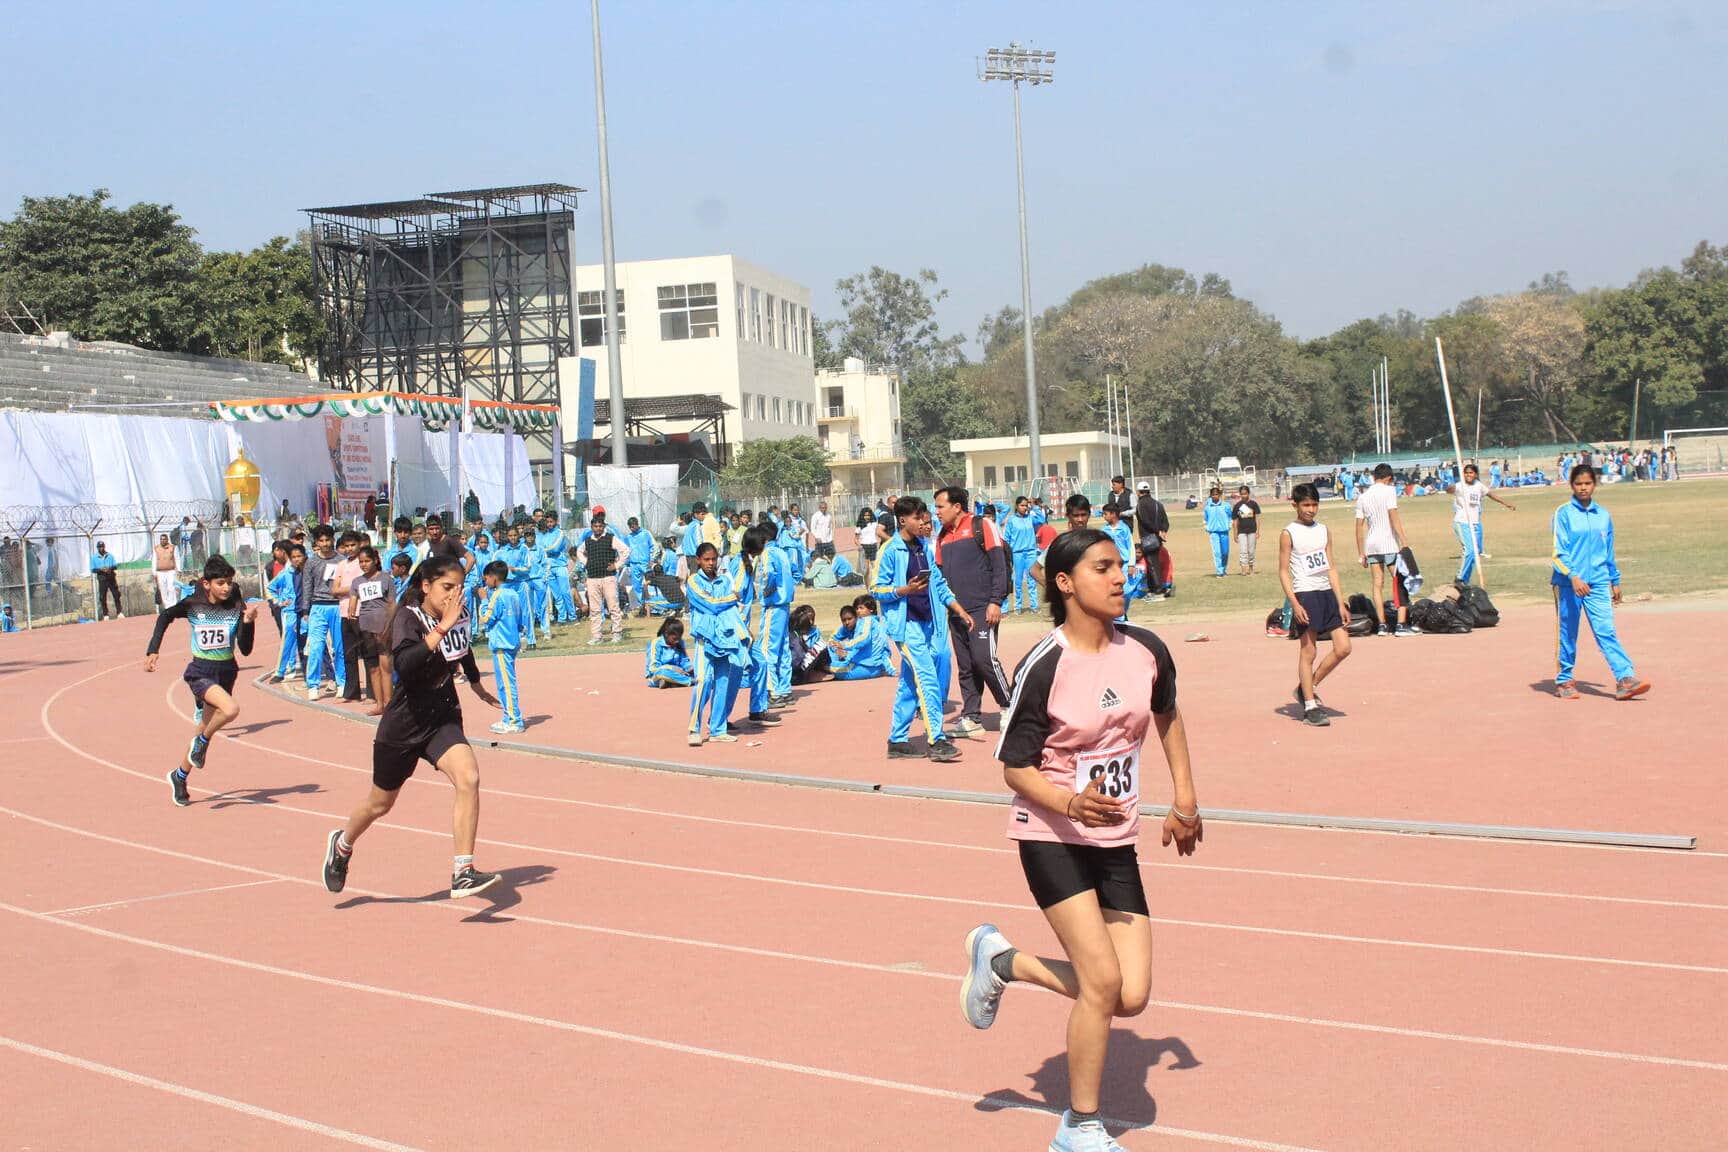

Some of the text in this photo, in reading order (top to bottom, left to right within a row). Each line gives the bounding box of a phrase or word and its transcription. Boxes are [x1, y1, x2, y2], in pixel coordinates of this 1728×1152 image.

[1306, 551, 1326, 569] 362
[362, 584, 379, 598] 162
[200, 629, 225, 645] 375
[443, 626, 468, 654] 903
[1089, 755, 1133, 798] 833
